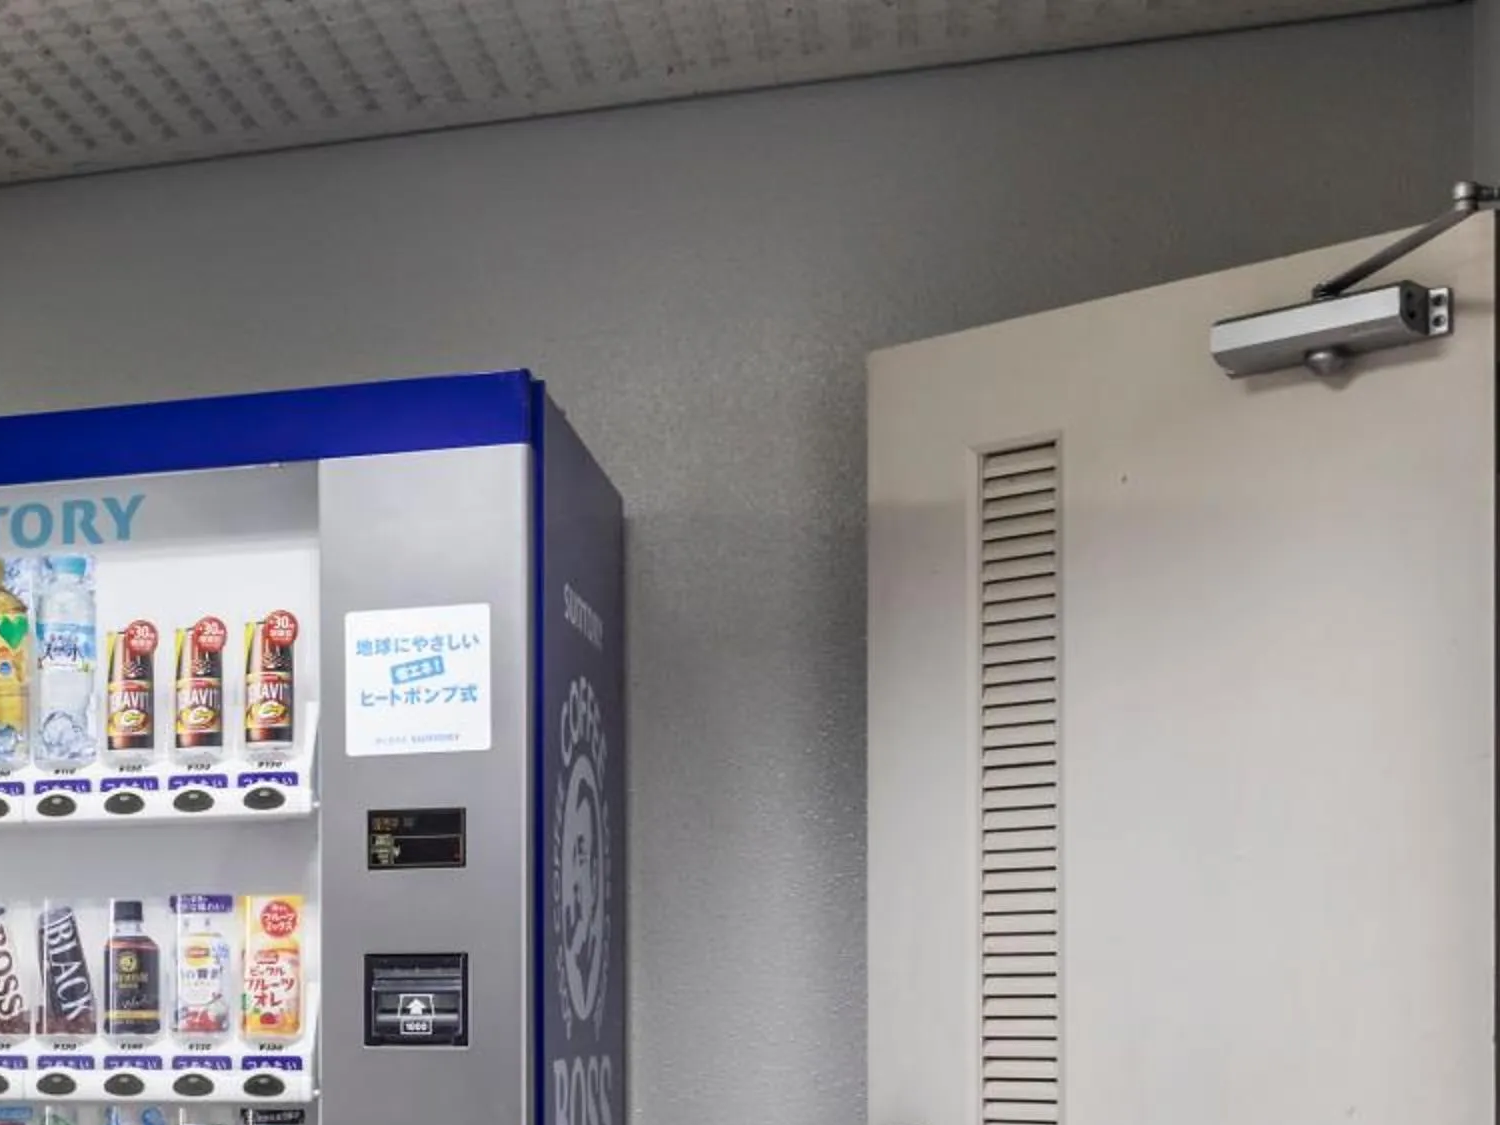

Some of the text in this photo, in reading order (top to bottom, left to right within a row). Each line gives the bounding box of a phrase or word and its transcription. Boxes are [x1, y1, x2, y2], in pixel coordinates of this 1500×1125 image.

[356, 633, 480, 656] 地球にやさしい
[360, 684, 478, 707] ヒートポンプ式
[46, 914, 92, 1020] BLACK
[406, 1020, 428, 1031] 1000
